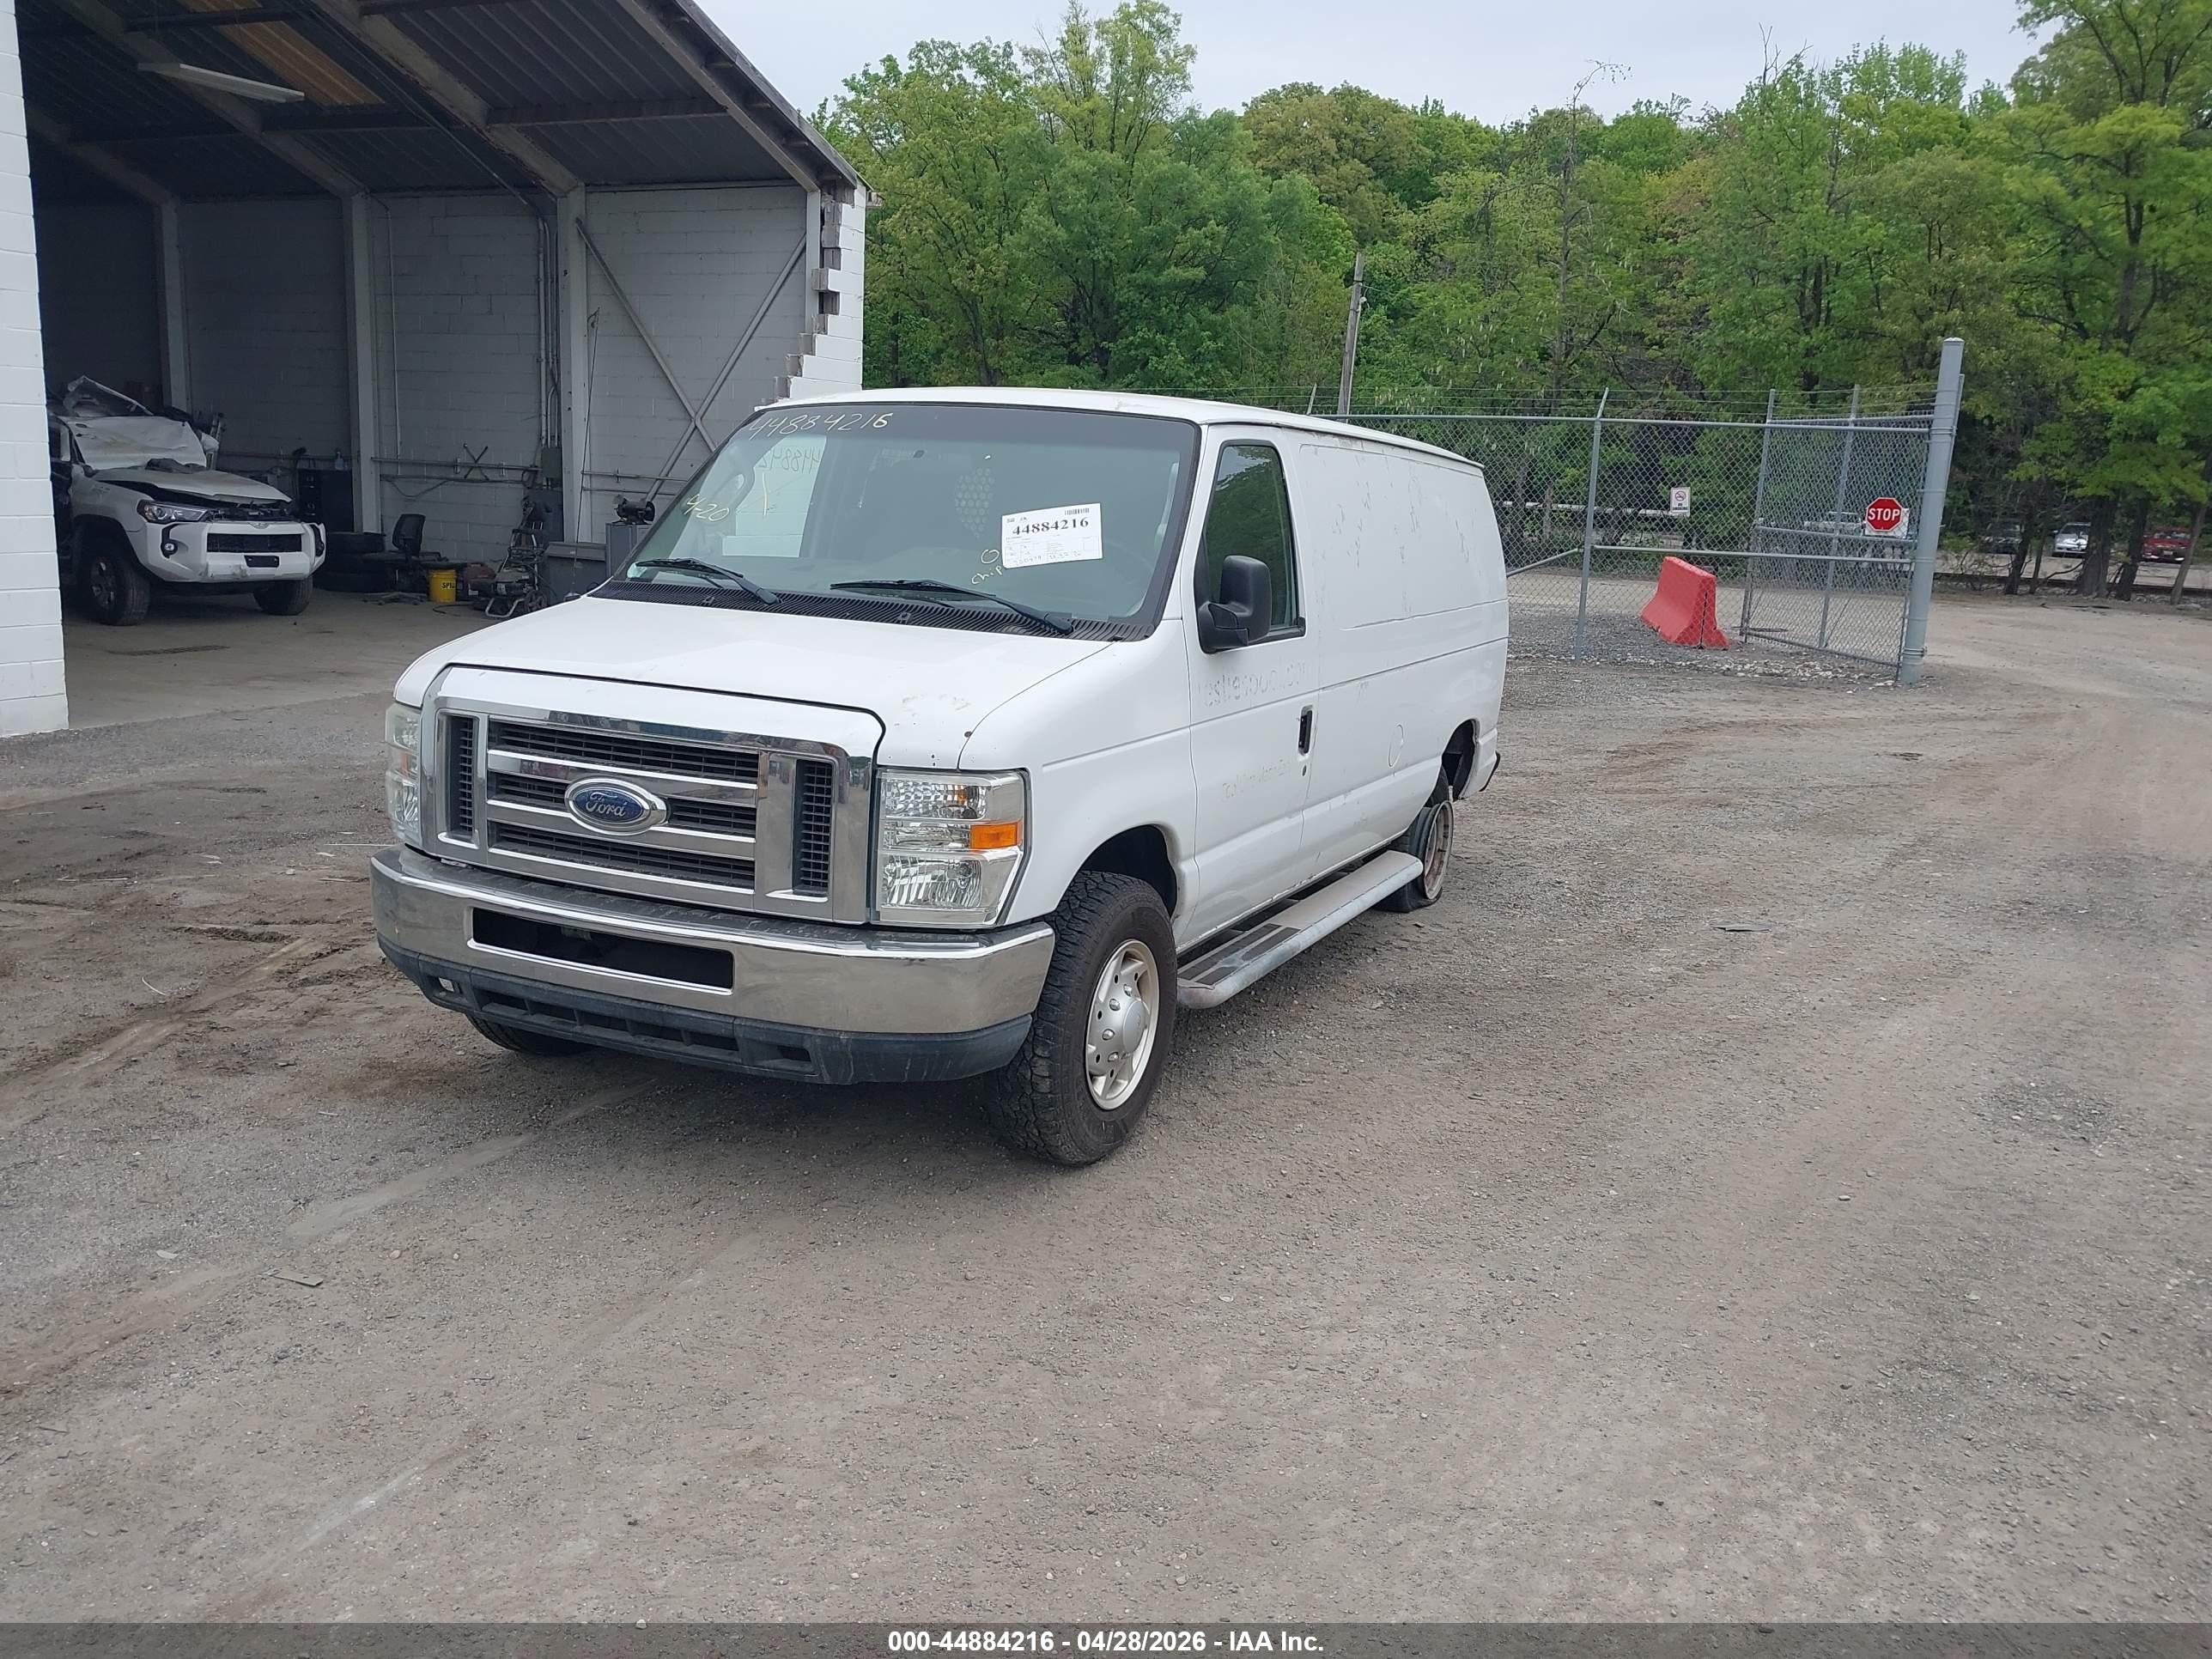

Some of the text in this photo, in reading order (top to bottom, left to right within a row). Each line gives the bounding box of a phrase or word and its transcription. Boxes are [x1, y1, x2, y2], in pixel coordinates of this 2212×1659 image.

[749, 412, 894, 441] 44884216
[1868, 507, 1900, 521] STOP
[1012, 516, 1090, 536] 44884216
[585, 791, 627, 817] Ford
